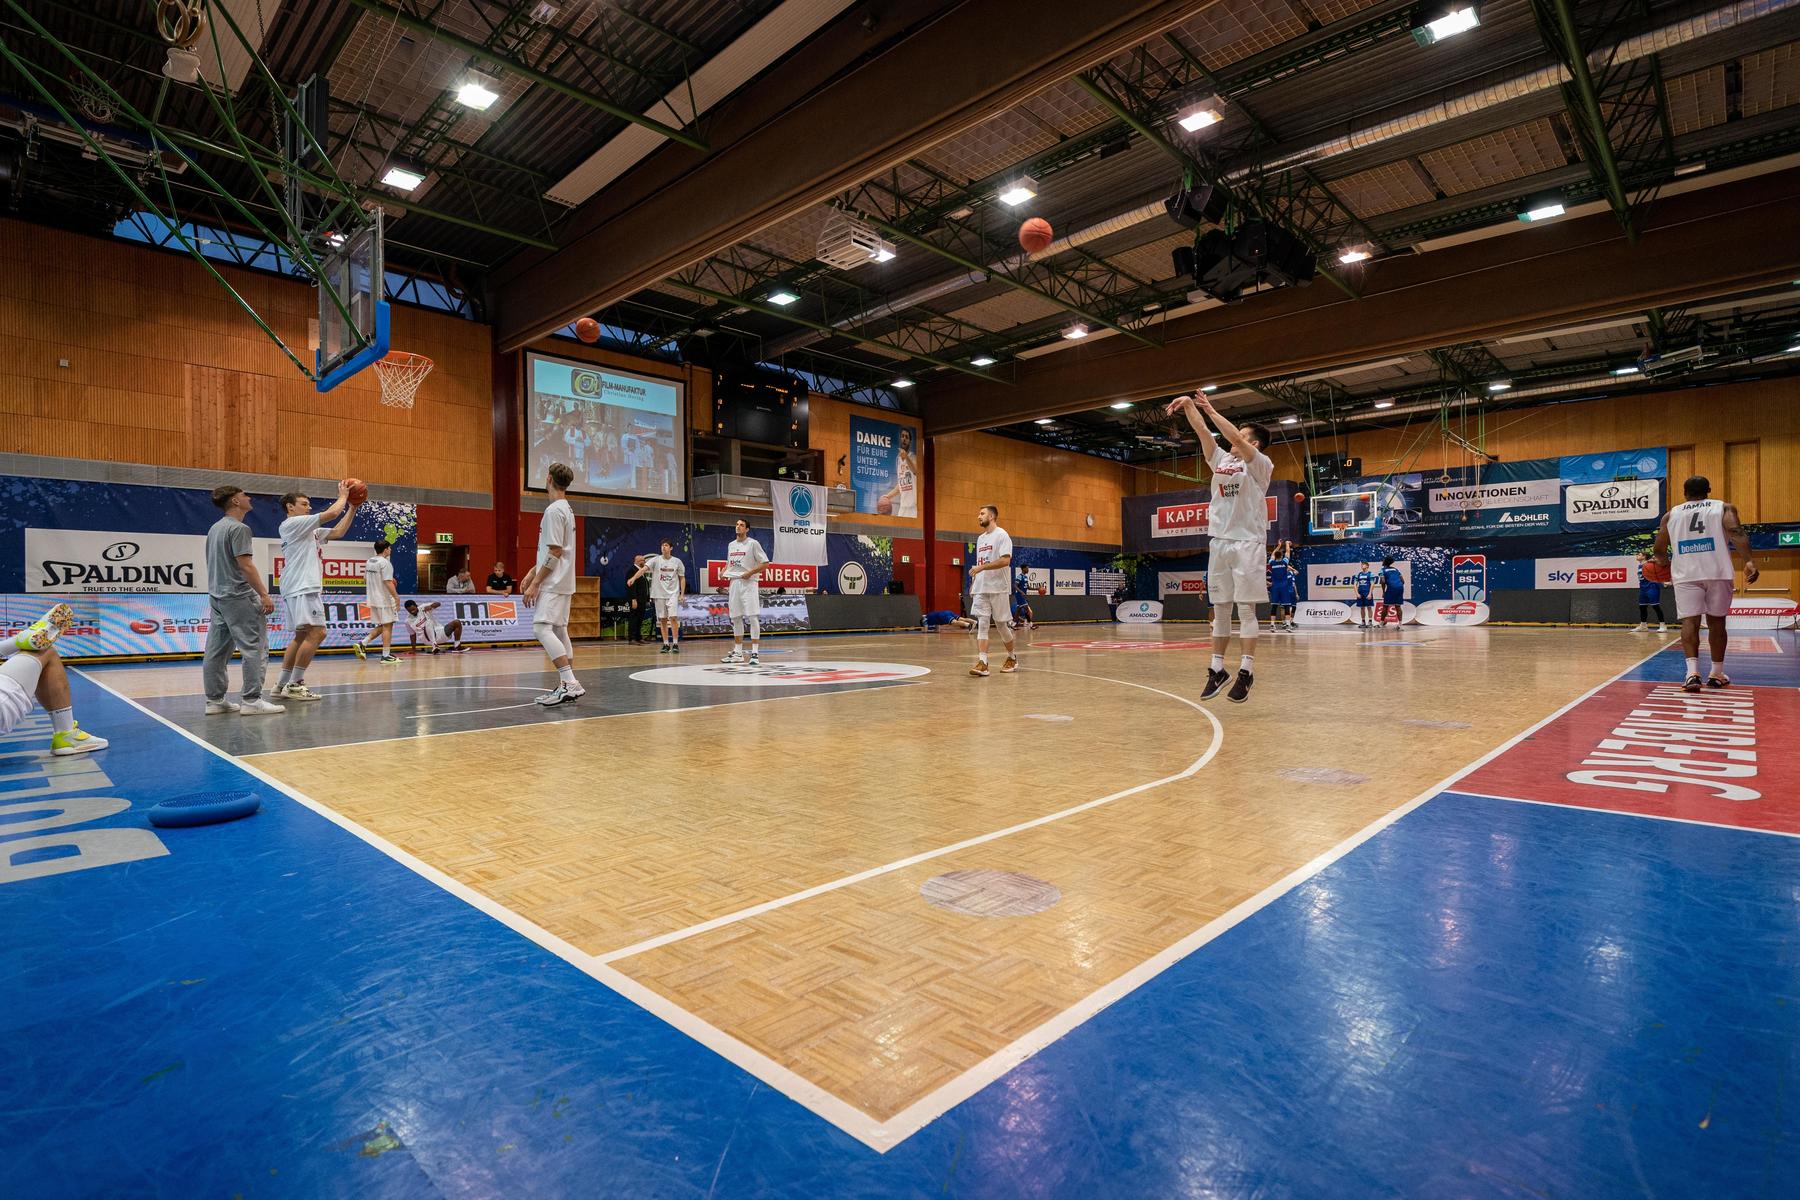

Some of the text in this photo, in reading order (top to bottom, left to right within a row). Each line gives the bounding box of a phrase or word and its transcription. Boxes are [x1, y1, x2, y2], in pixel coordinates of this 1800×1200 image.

[856, 431, 892, 448] DANKE
[857, 444, 888, 458] FÜR EURE
[856, 456, 881, 467] UNTER-
[856, 465, 889, 478] STÜTZUNG
[1435, 486, 1527, 501] INNOVATIONEN
[1573, 495, 1649, 514] SPALDING
[1166, 508, 1210, 523] KAPFE
[1513, 512, 1549, 522] BÖHLER
[793, 519, 811, 527] FIBA
[1689, 511, 1706, 534] 4
[779, 526, 825, 535] EUROPE CUP
[42, 560, 194, 588] SPALDING
[1548, 570, 1624, 583] sky sport
[1165, 581, 1181, 591] sky
[1306, 608, 1344, 617] fürstaller
